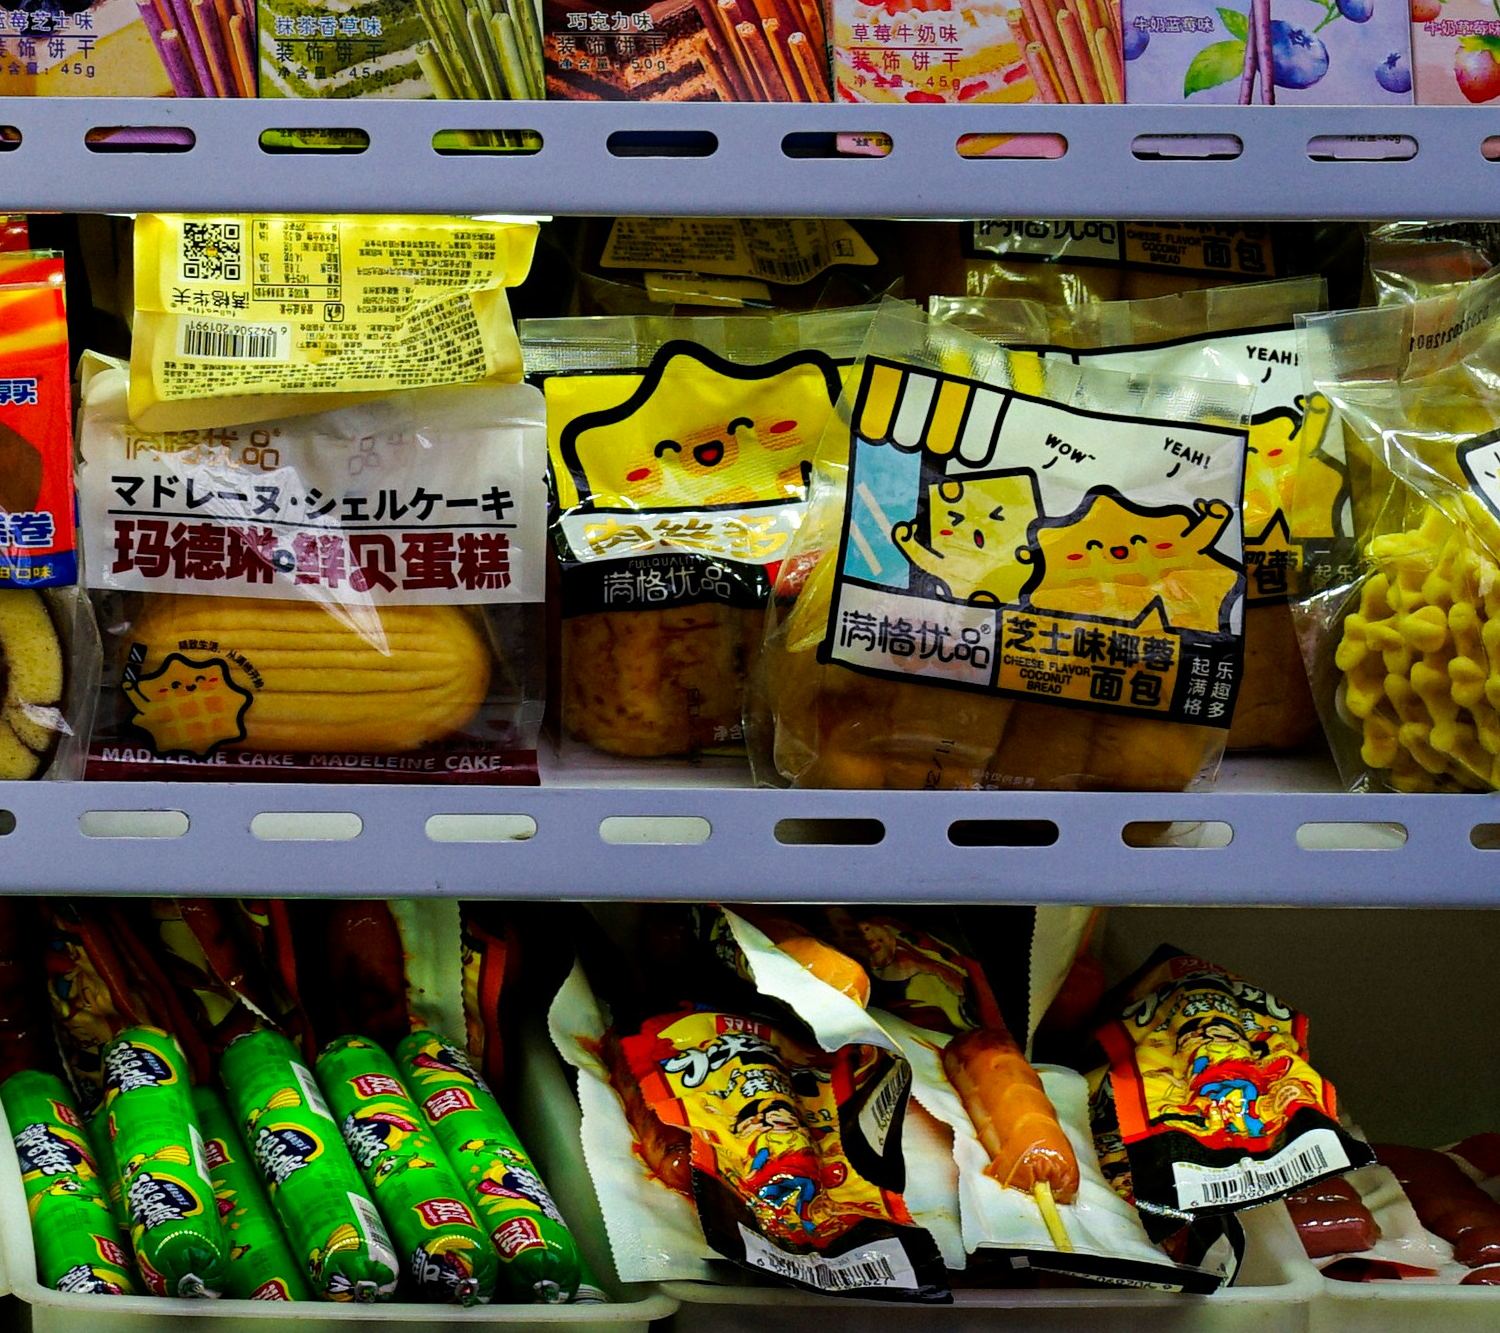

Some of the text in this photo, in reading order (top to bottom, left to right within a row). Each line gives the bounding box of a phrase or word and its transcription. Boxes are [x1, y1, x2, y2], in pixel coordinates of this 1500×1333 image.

[1134, 16, 1214, 32] 牛奶蓝莓味
[1162, 437, 1211, 470] YEAH!
[840, 613, 983, 671] 满格优品
[1004, 655, 1091, 678] CHEESE FLAVOR
[1090, 664, 1170, 709] 面包
